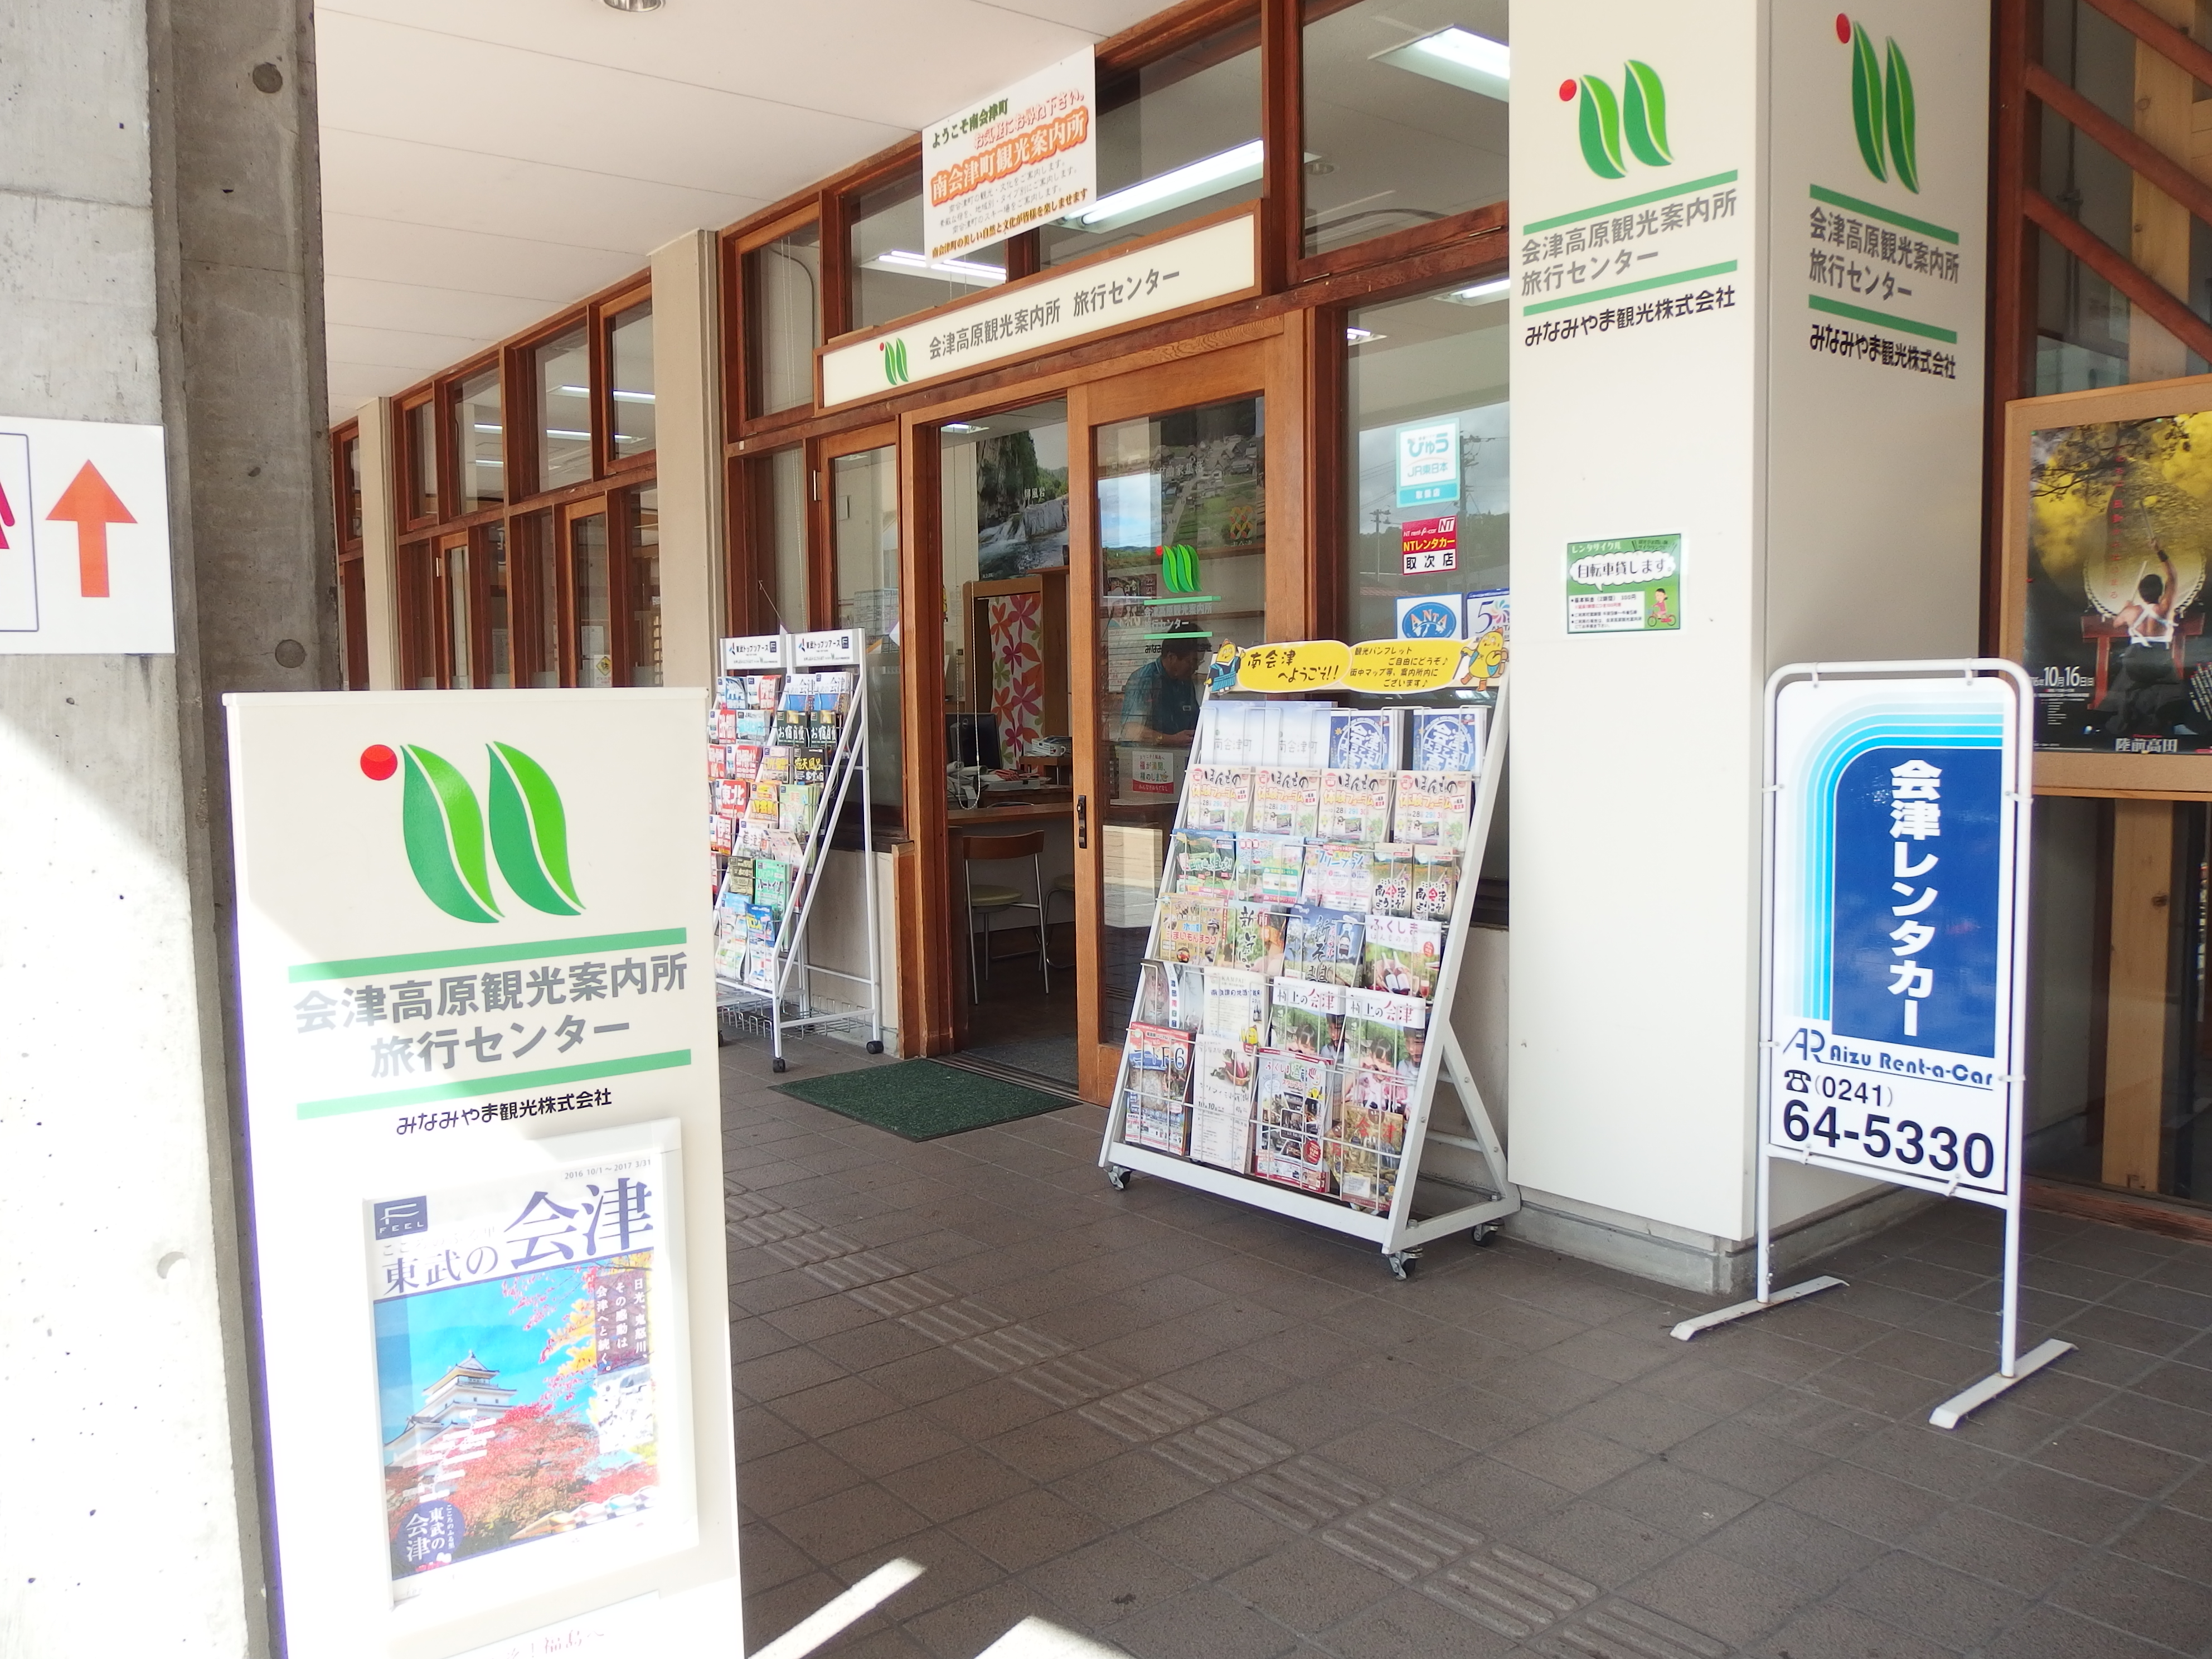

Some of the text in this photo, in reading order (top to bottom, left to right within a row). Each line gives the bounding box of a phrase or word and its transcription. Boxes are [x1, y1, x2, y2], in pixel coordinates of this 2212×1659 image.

[932, 98, 1008, 149] ようこそ南会津町
[932, 111, 1085, 202] 南会津町観光案内所
[1522, 188, 1737, 265] 会津高原観光案内所
[1809, 206, 1959, 284] 会津高原観光案内所
[1522, 249, 1659, 296] 旅行センター
[1809, 248, 1912, 301] 旅行センター
[929, 269, 1180, 361] 会津高原観光案内所 旅行センター
[1525, 285, 1735, 347] みなみやま観光株式会社
[1810, 323, 1957, 380] みなみやま観光株式会社
[1407, 433, 1449, 457] びゅう
[1408, 462, 1448, 477] JR東日本
[1404, 537, 1455, 552] NTレンタカー
[1439, 518, 1454, 532] NT
[1572, 541, 1622, 554] レンタサイクル
[1578, 559, 1671, 578] 自転車貸します。
[1248, 649, 1296, 668] 南会津
[1355, 647, 1412, 656] 観光パンフレット
[2116, 738, 2178, 752] 陸前高田
[721, 784, 744, 806] 東北
[1887, 759, 1942, 1037] 会津レンタカー
[293, 951, 688, 1034] 会津高原観光案内所
[371, 1014, 630, 1079] 旅行センター
[1830, 1044, 1871, 1066] Aizu
[1879, 1052, 1993, 1086] Rent-a-Car
[395, 1088, 613, 1135] みなみやま観光株式会社
[1815, 1075, 1893, 1108] (0241)
[1784, 1099, 1994, 1178] 64-5330
[564, 1170, 584, 1180] 2016
[379, 1221, 424, 1234] FEEL
[595, 1285, 612, 1371] 会津へと続く。
[615, 1282, 628, 1349] その感動は
[634, 1278, 647, 1359] 日光、鬼怒川、
[405, 1512, 431, 1562] 会津
[429, 1506, 445, 1550] 東武の
